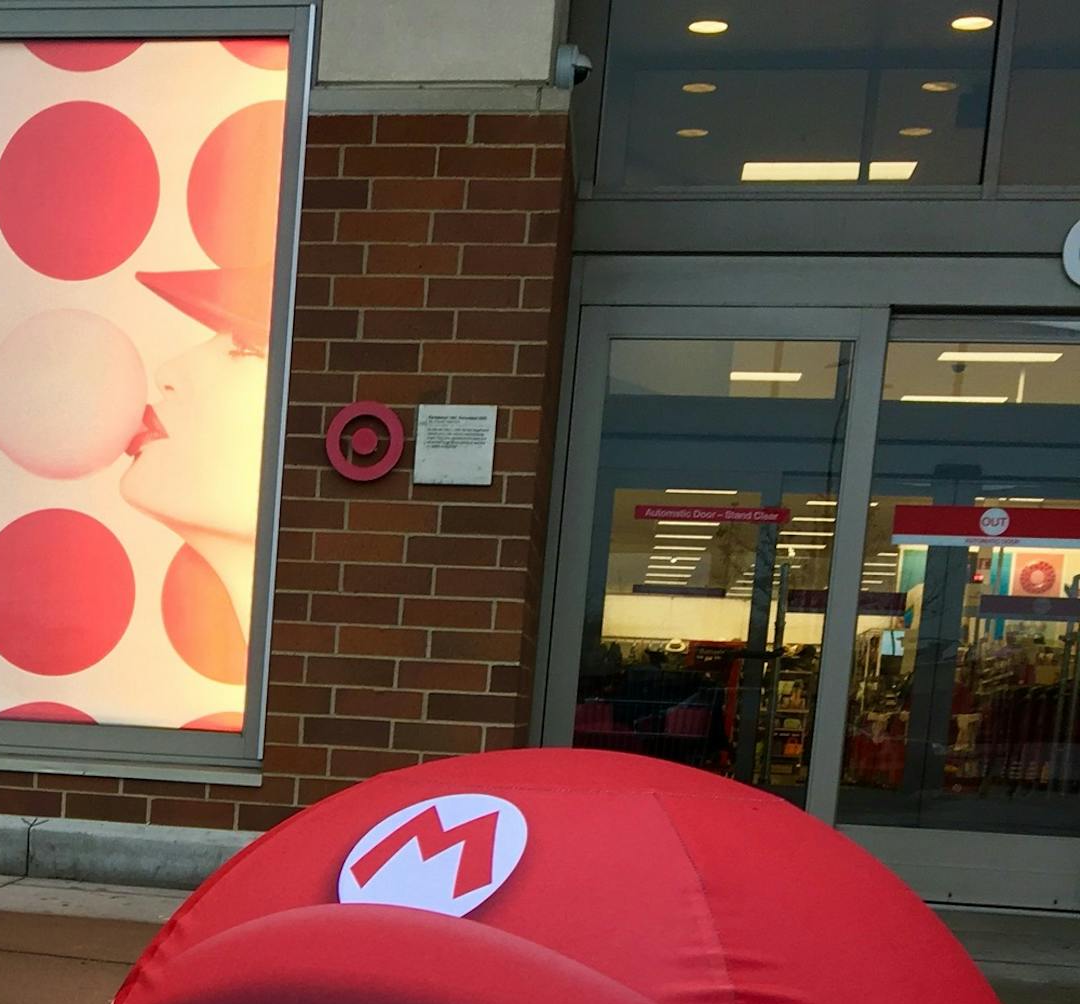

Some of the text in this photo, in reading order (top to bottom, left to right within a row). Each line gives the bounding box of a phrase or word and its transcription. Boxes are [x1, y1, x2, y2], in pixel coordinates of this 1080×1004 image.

[645, 508, 691, 518] Automatic
[693, 509, 715, 519] Door
[725, 510, 752, 520] Stand
[754, 510, 778, 521] Clear
[982, 517, 1008, 527] OUT
[350, 805, 499, 899] M
